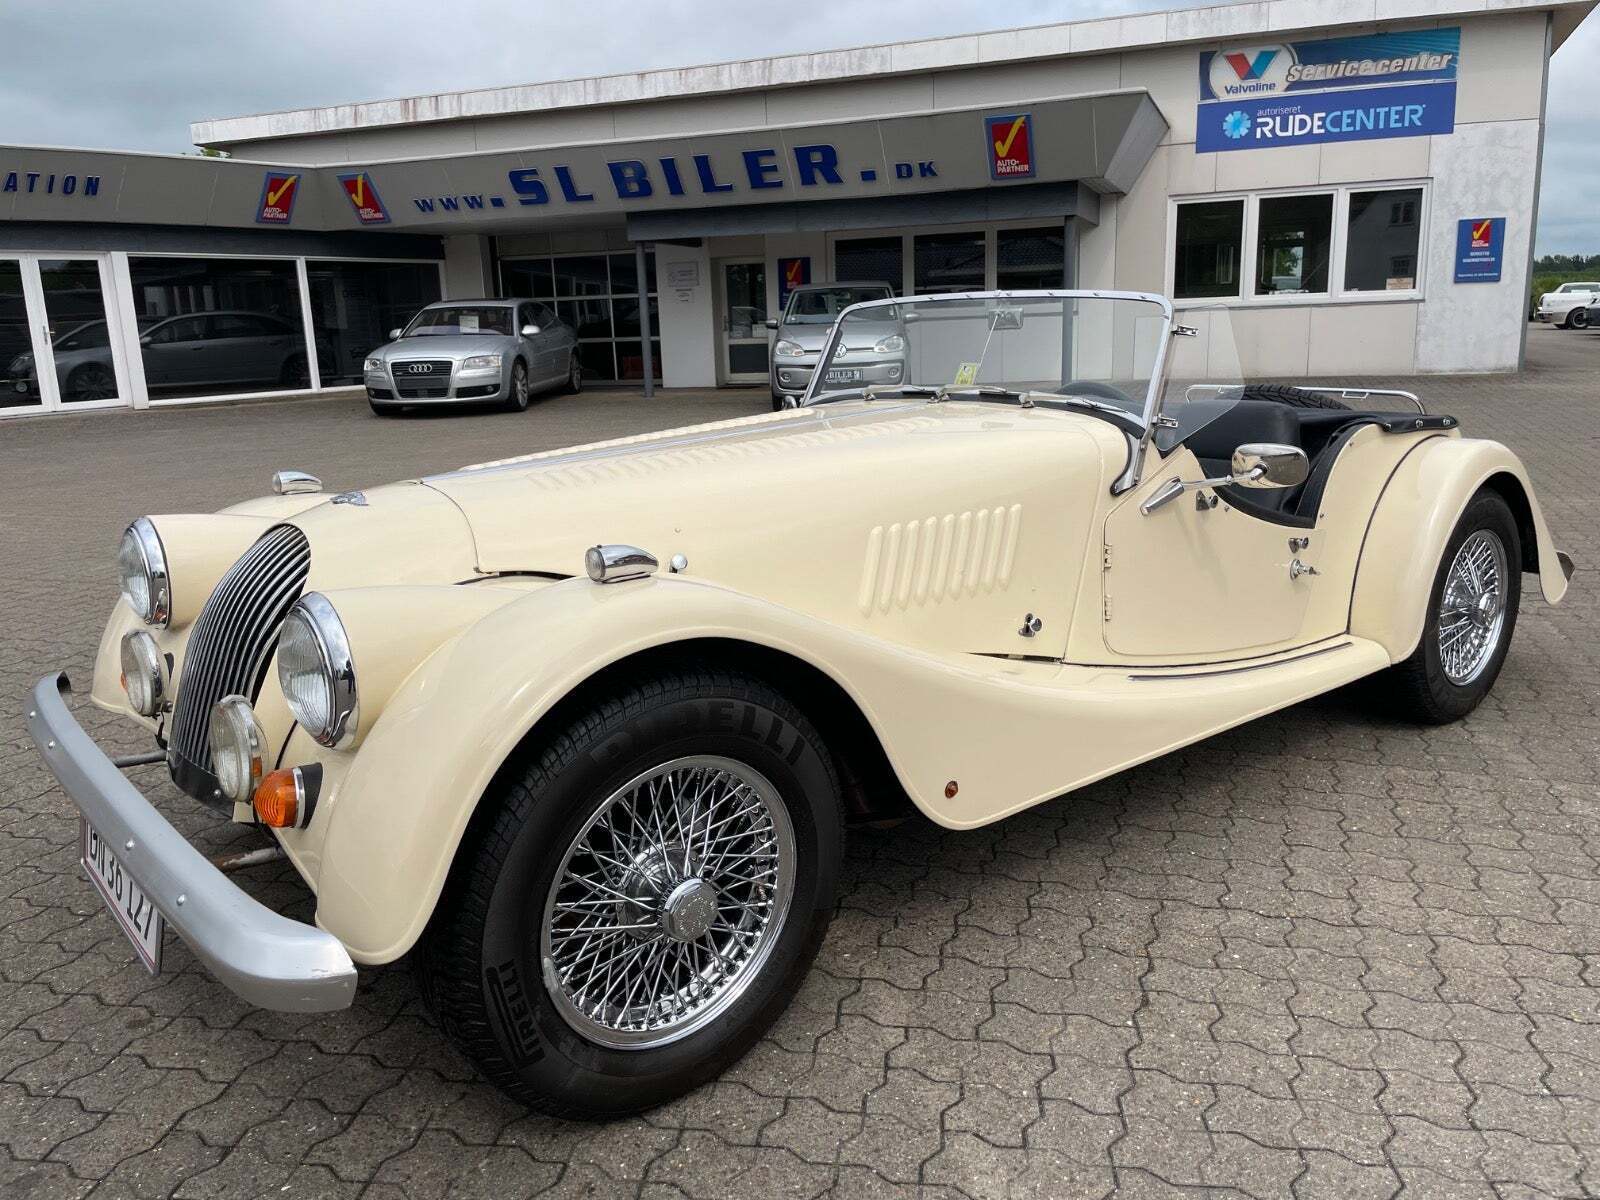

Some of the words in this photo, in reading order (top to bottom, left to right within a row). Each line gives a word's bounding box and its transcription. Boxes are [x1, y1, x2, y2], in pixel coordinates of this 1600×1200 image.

[1286, 52, 1453, 82] Servicecenter
[1224, 81, 1276, 95] Valvoline
[1256, 105, 1302, 117] autoriseret
[997, 159, 1020, 167] AUTO-
[997, 164, 1029, 174] PARTNER
[3, 171, 101, 196] ATION
[107, 855, 123, 902] 36
[485, 959, 546, 1069] PIRELLI
